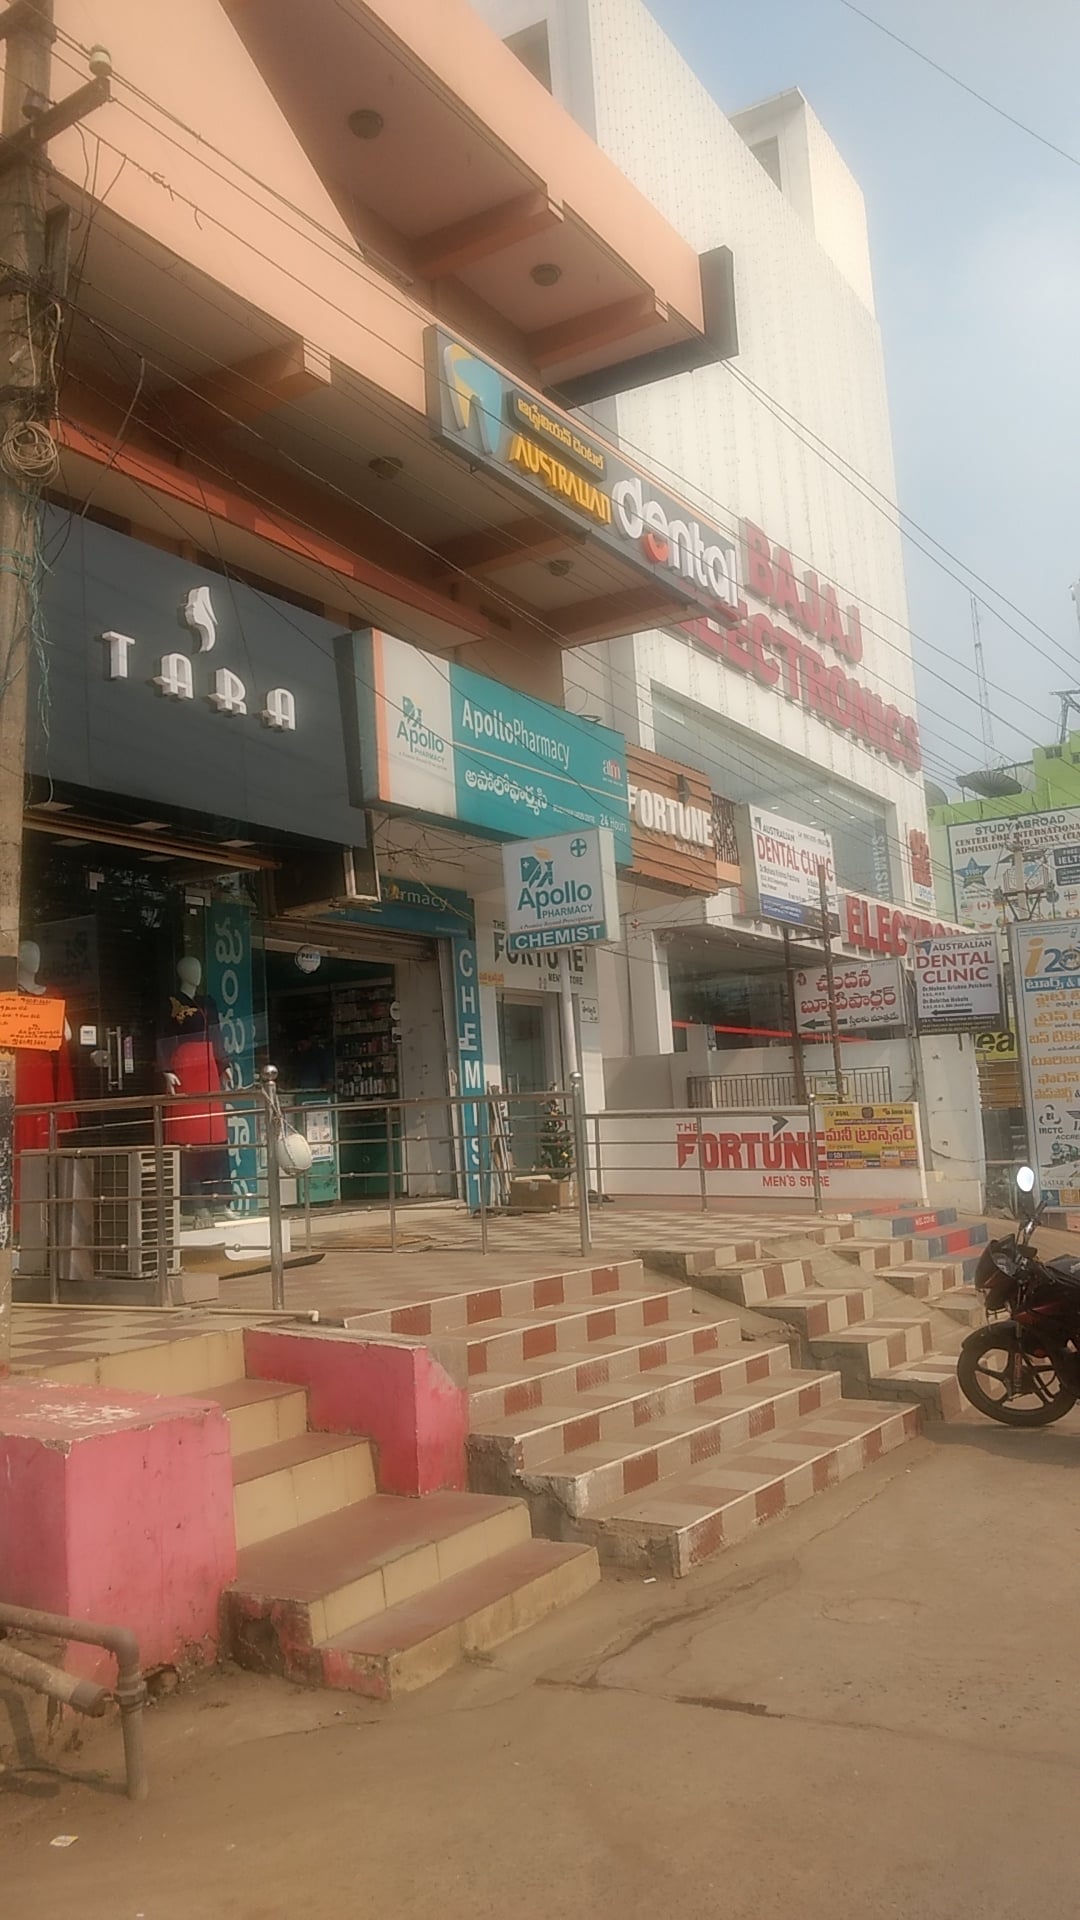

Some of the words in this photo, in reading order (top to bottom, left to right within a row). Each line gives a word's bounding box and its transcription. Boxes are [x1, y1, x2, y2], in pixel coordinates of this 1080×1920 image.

[509, 432, 612, 526] AUSTRALIAN
[612, 476, 739, 608] dental
[740, 516, 863, 666] BAJAJ
[102, 631, 296, 732] TARA
[396, 720, 445, 753] Apollo
[627, 783, 714, 848] FORTUNE
[975, 823, 1014, 836] STUDY
[1015, 814, 1066, 830] ABROAD
[955, 836, 989, 847] CENTER
[991, 833, 1011, 843] FOR
[756, 833, 800, 871] DENTAL
[801, 848, 834, 882] CLINIC
[1058, 854, 1080, 865] IELT
[517, 880, 592, 919] Apollo
[542, 903, 593, 918] PHARMACY
[515, 924, 601, 949] CHEMIST
[932, 940, 992, 952] AUSTRALIAN
[915, 950, 995, 969] DENTAL
[922, 966, 989, 985] CLINIC
[458, 949, 483, 1206] CHEMIST
[676, 1122, 698, 1132] THE
[677, 1131, 827, 1170] FORTUNE
[762, 1175, 796, 1187] MEN'S
